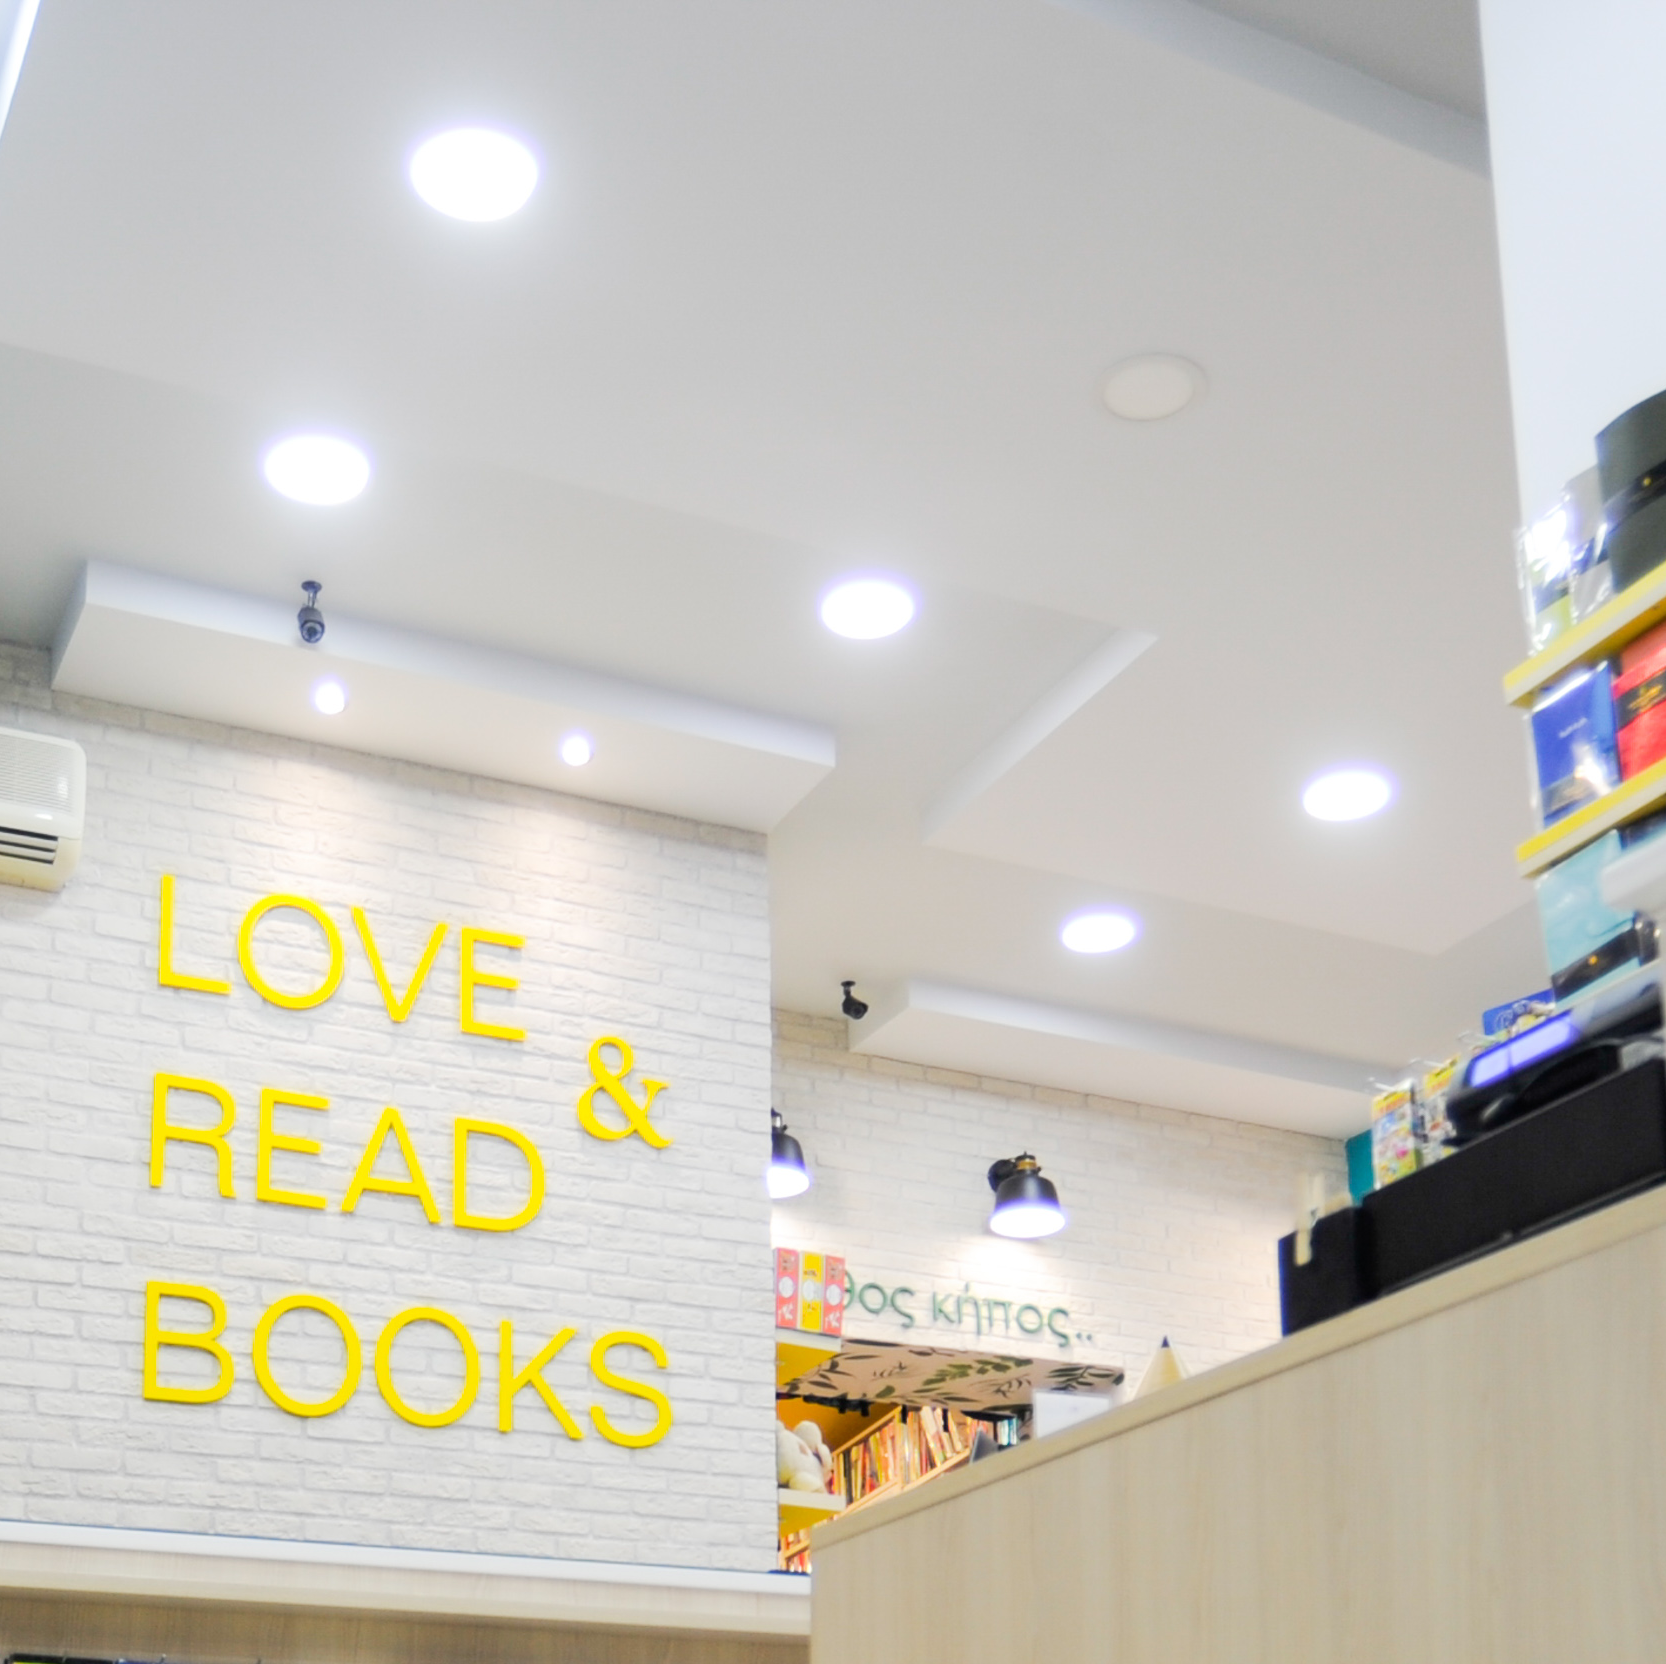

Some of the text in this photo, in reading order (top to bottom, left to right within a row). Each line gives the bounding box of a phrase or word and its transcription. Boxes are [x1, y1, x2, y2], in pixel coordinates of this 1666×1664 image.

[157, 874, 526, 1042] LOVE
[149, 1035, 674, 1233] READ &
[141, 1279, 675, 1450] BOOKS
